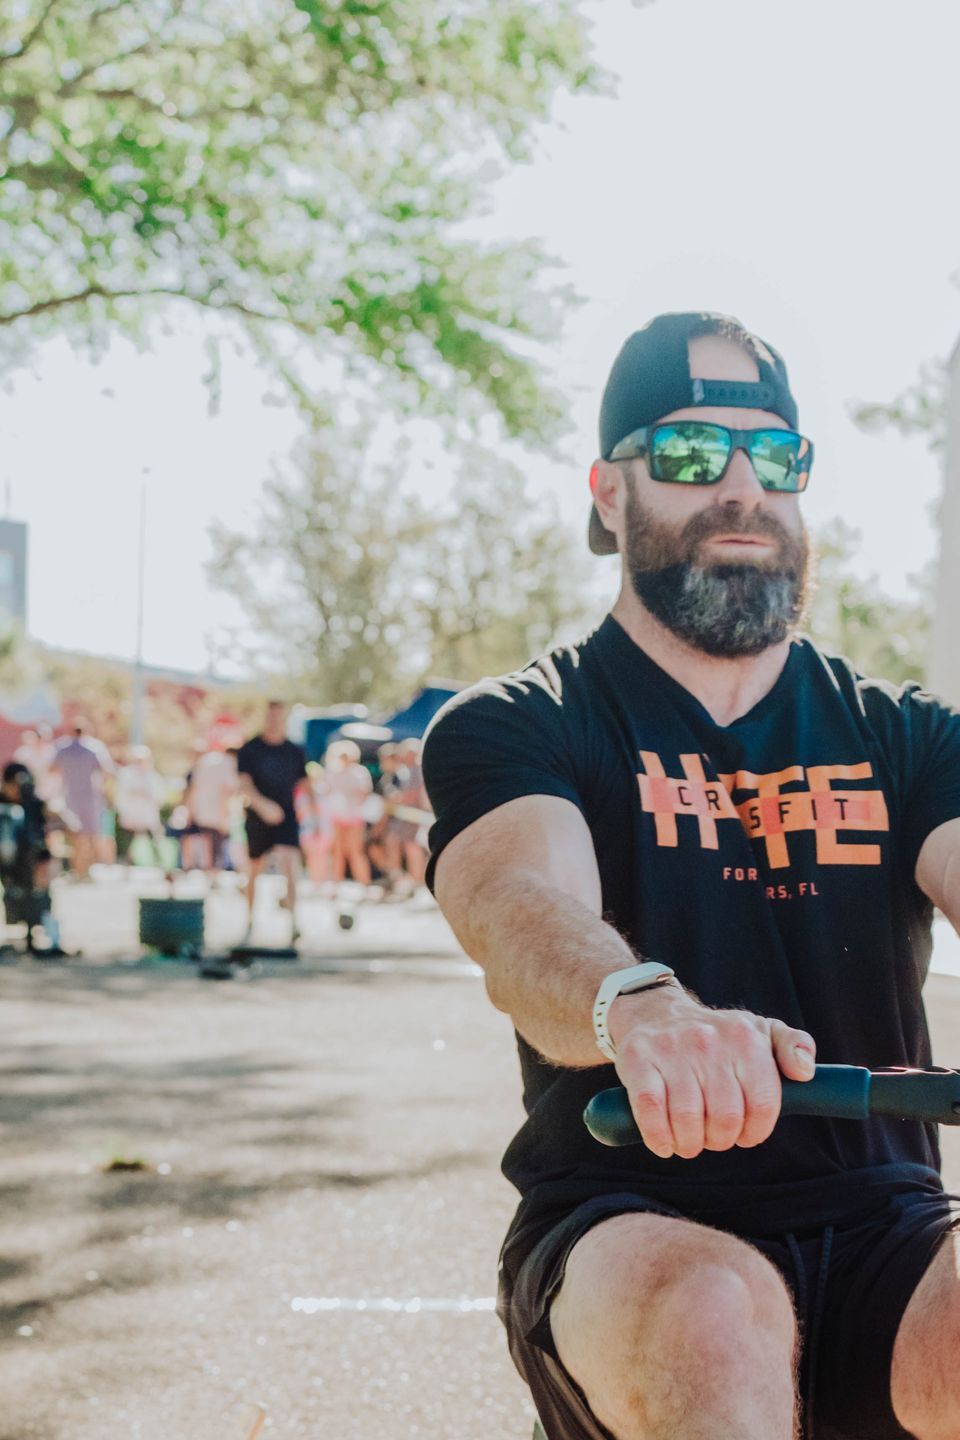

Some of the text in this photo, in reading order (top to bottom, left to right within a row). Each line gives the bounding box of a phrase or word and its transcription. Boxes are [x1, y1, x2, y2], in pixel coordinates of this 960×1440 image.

[678, 786, 848, 830] CRSFIT
[722, 867, 758, 881] FOR
[799, 882, 819, 897] FL
